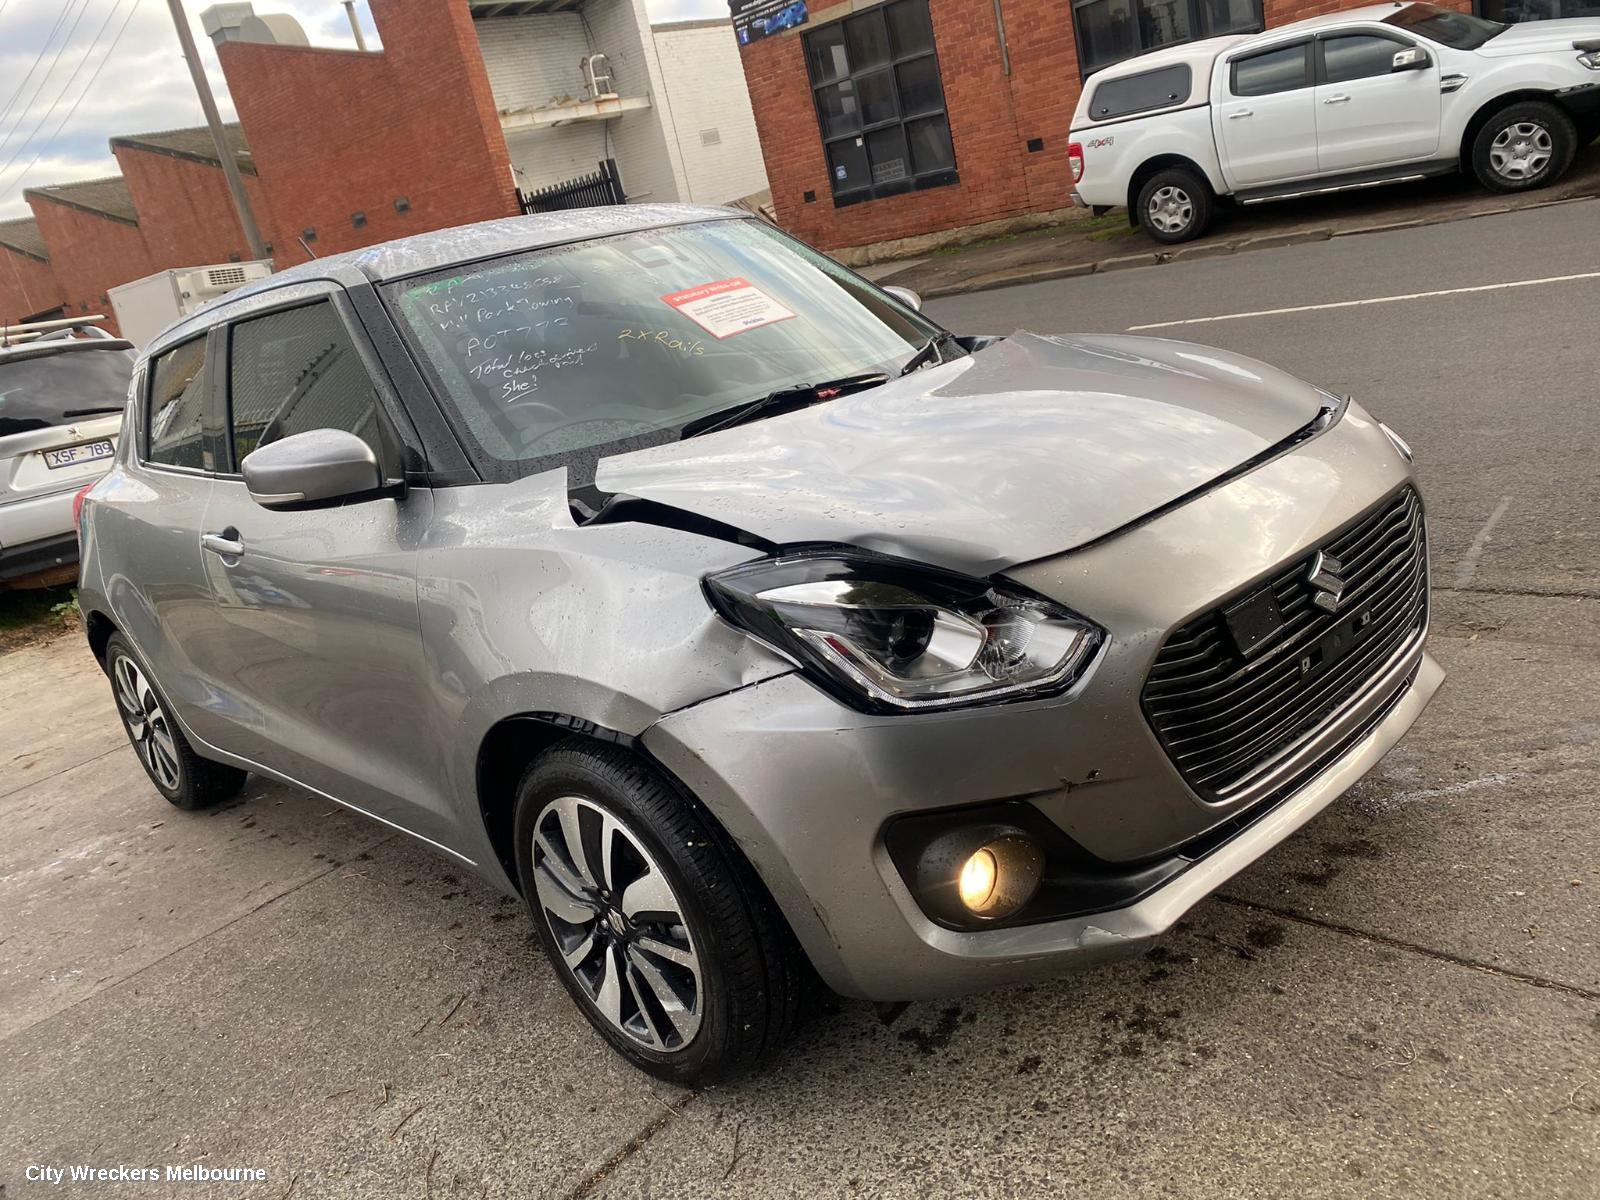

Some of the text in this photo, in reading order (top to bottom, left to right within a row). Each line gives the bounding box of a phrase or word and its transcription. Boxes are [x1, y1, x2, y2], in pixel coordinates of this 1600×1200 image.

[655, 330, 705, 355] Rails
[51, 442, 112, 465] XSF 789
